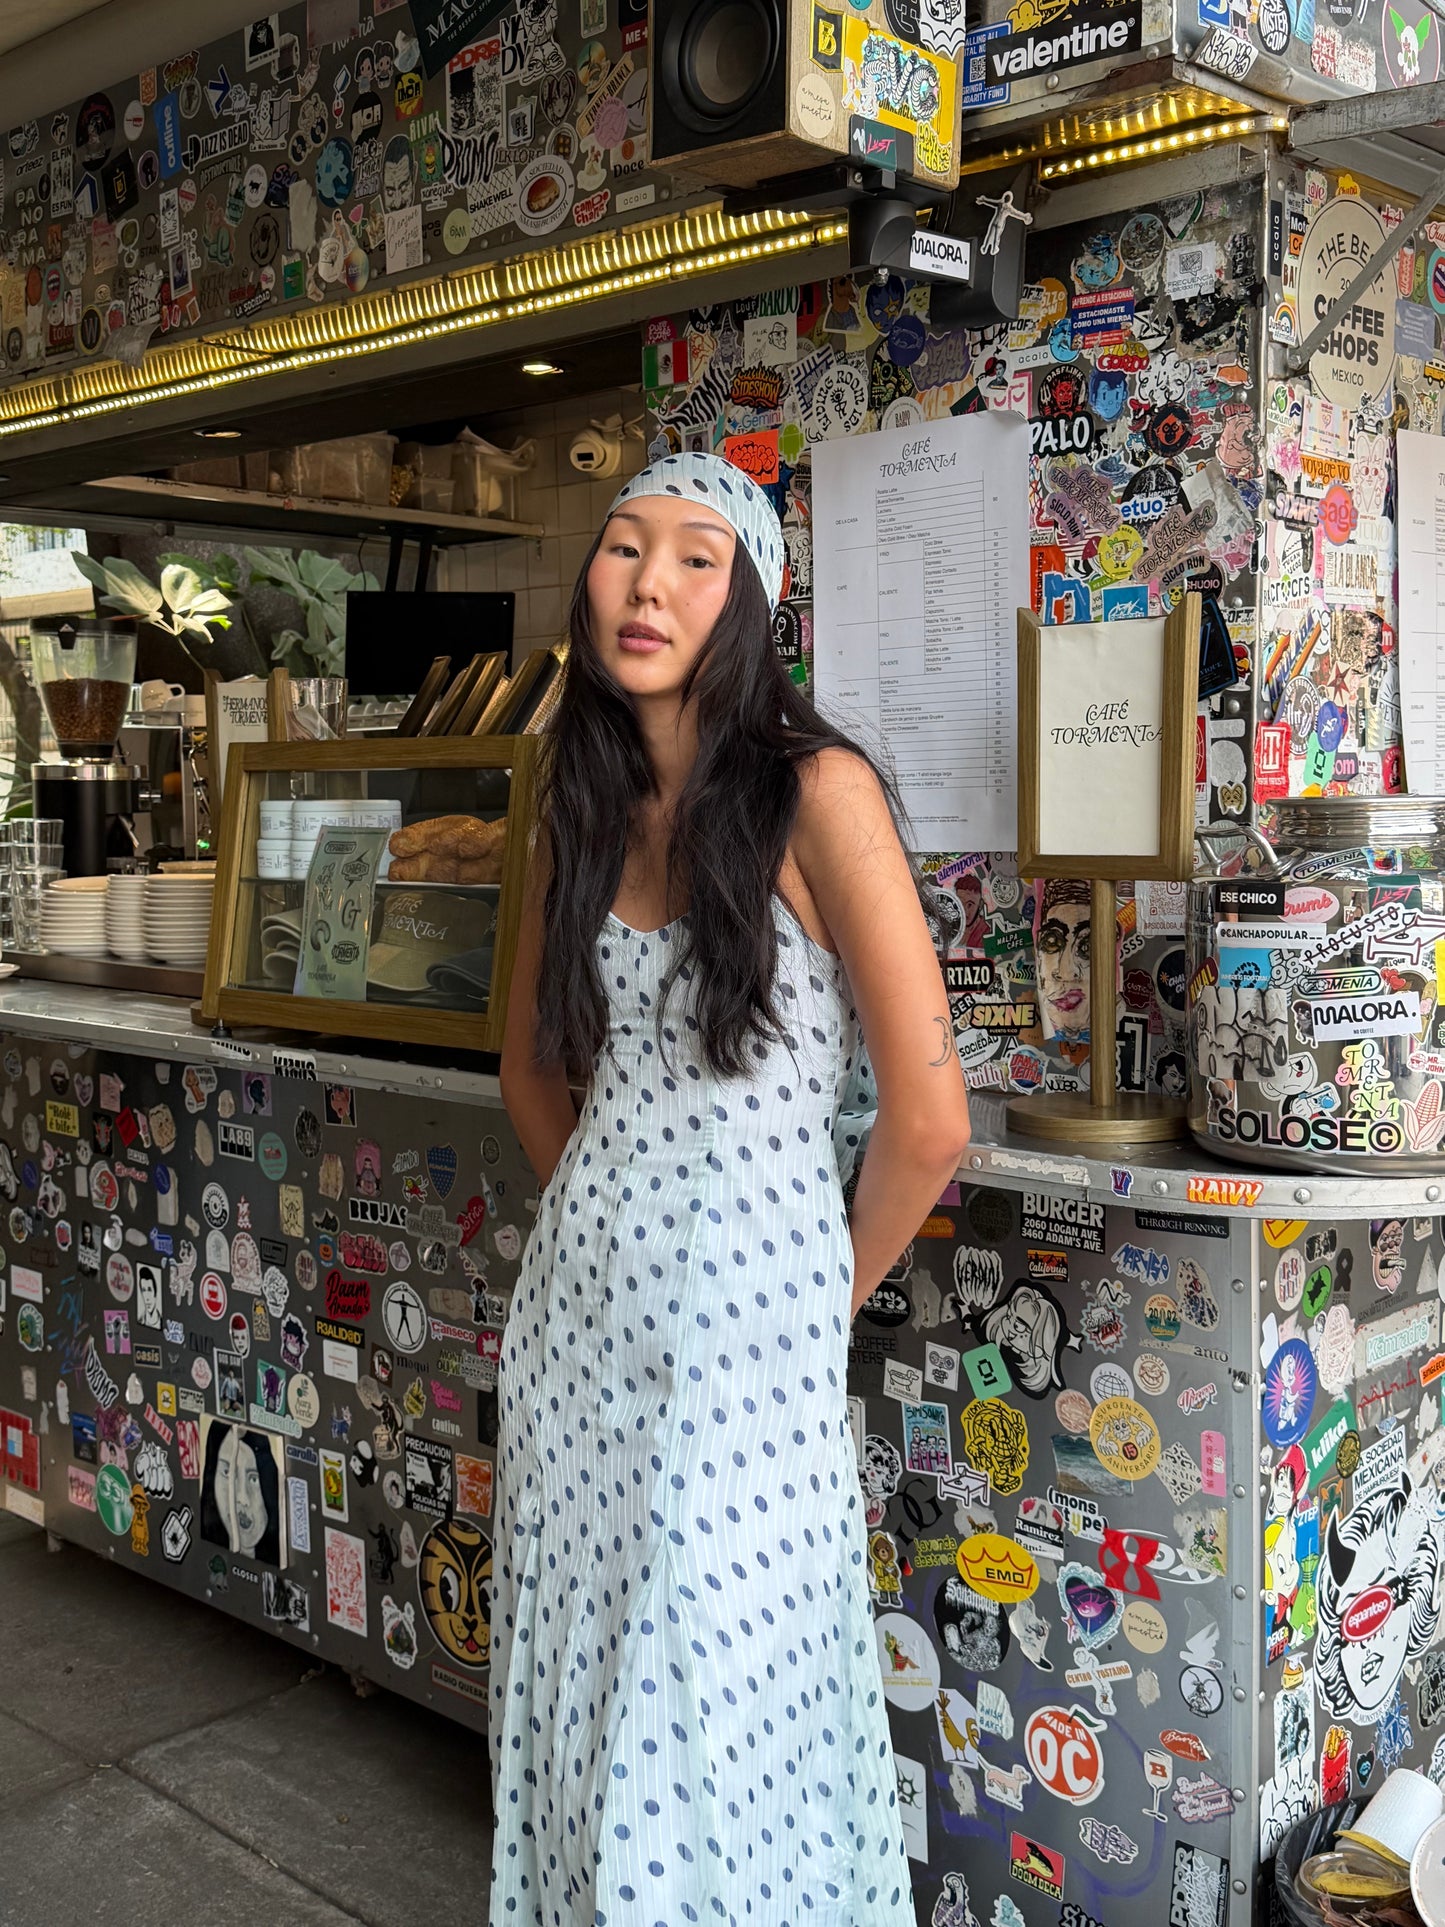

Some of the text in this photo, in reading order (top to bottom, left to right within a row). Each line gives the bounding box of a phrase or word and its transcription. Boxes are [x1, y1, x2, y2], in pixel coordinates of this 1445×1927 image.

[163, 104, 177, 169] outline
[1072, 314, 1132, 330] COMO UNA MIERDA
[1078, 305, 1126, 320] ESTACIONASTE
[741, 408, 783, 429] Gemini
[901, 436, 932, 461] CAFÉ
[879, 452, 958, 478] TORMENTA
[1318, 499, 1359, 534] sage
[1085, 699, 1129, 726] CAFÉ
[1219, 891, 1277, 905] ESE CHICO
[1022, 1191, 1105, 1229] BURGER
[1021, 1227, 1104, 1254] 3460 ADAM'S AVE.
[1024, 1217, 1102, 1242] 2060 LOGAN AVE.
[431, 1321, 476, 1343] Canseco
[1365, 1430, 1404, 1464] SOCIEDAD
[1354, 1446, 1405, 1491] MEXICANA
[232, 1566, 259, 1583] CLOSER
[1066, 1671, 1093, 1686] CENTRO
[1040, 1711, 1088, 1742] MADE IN
[1030, 1726, 1094, 1794] OC
